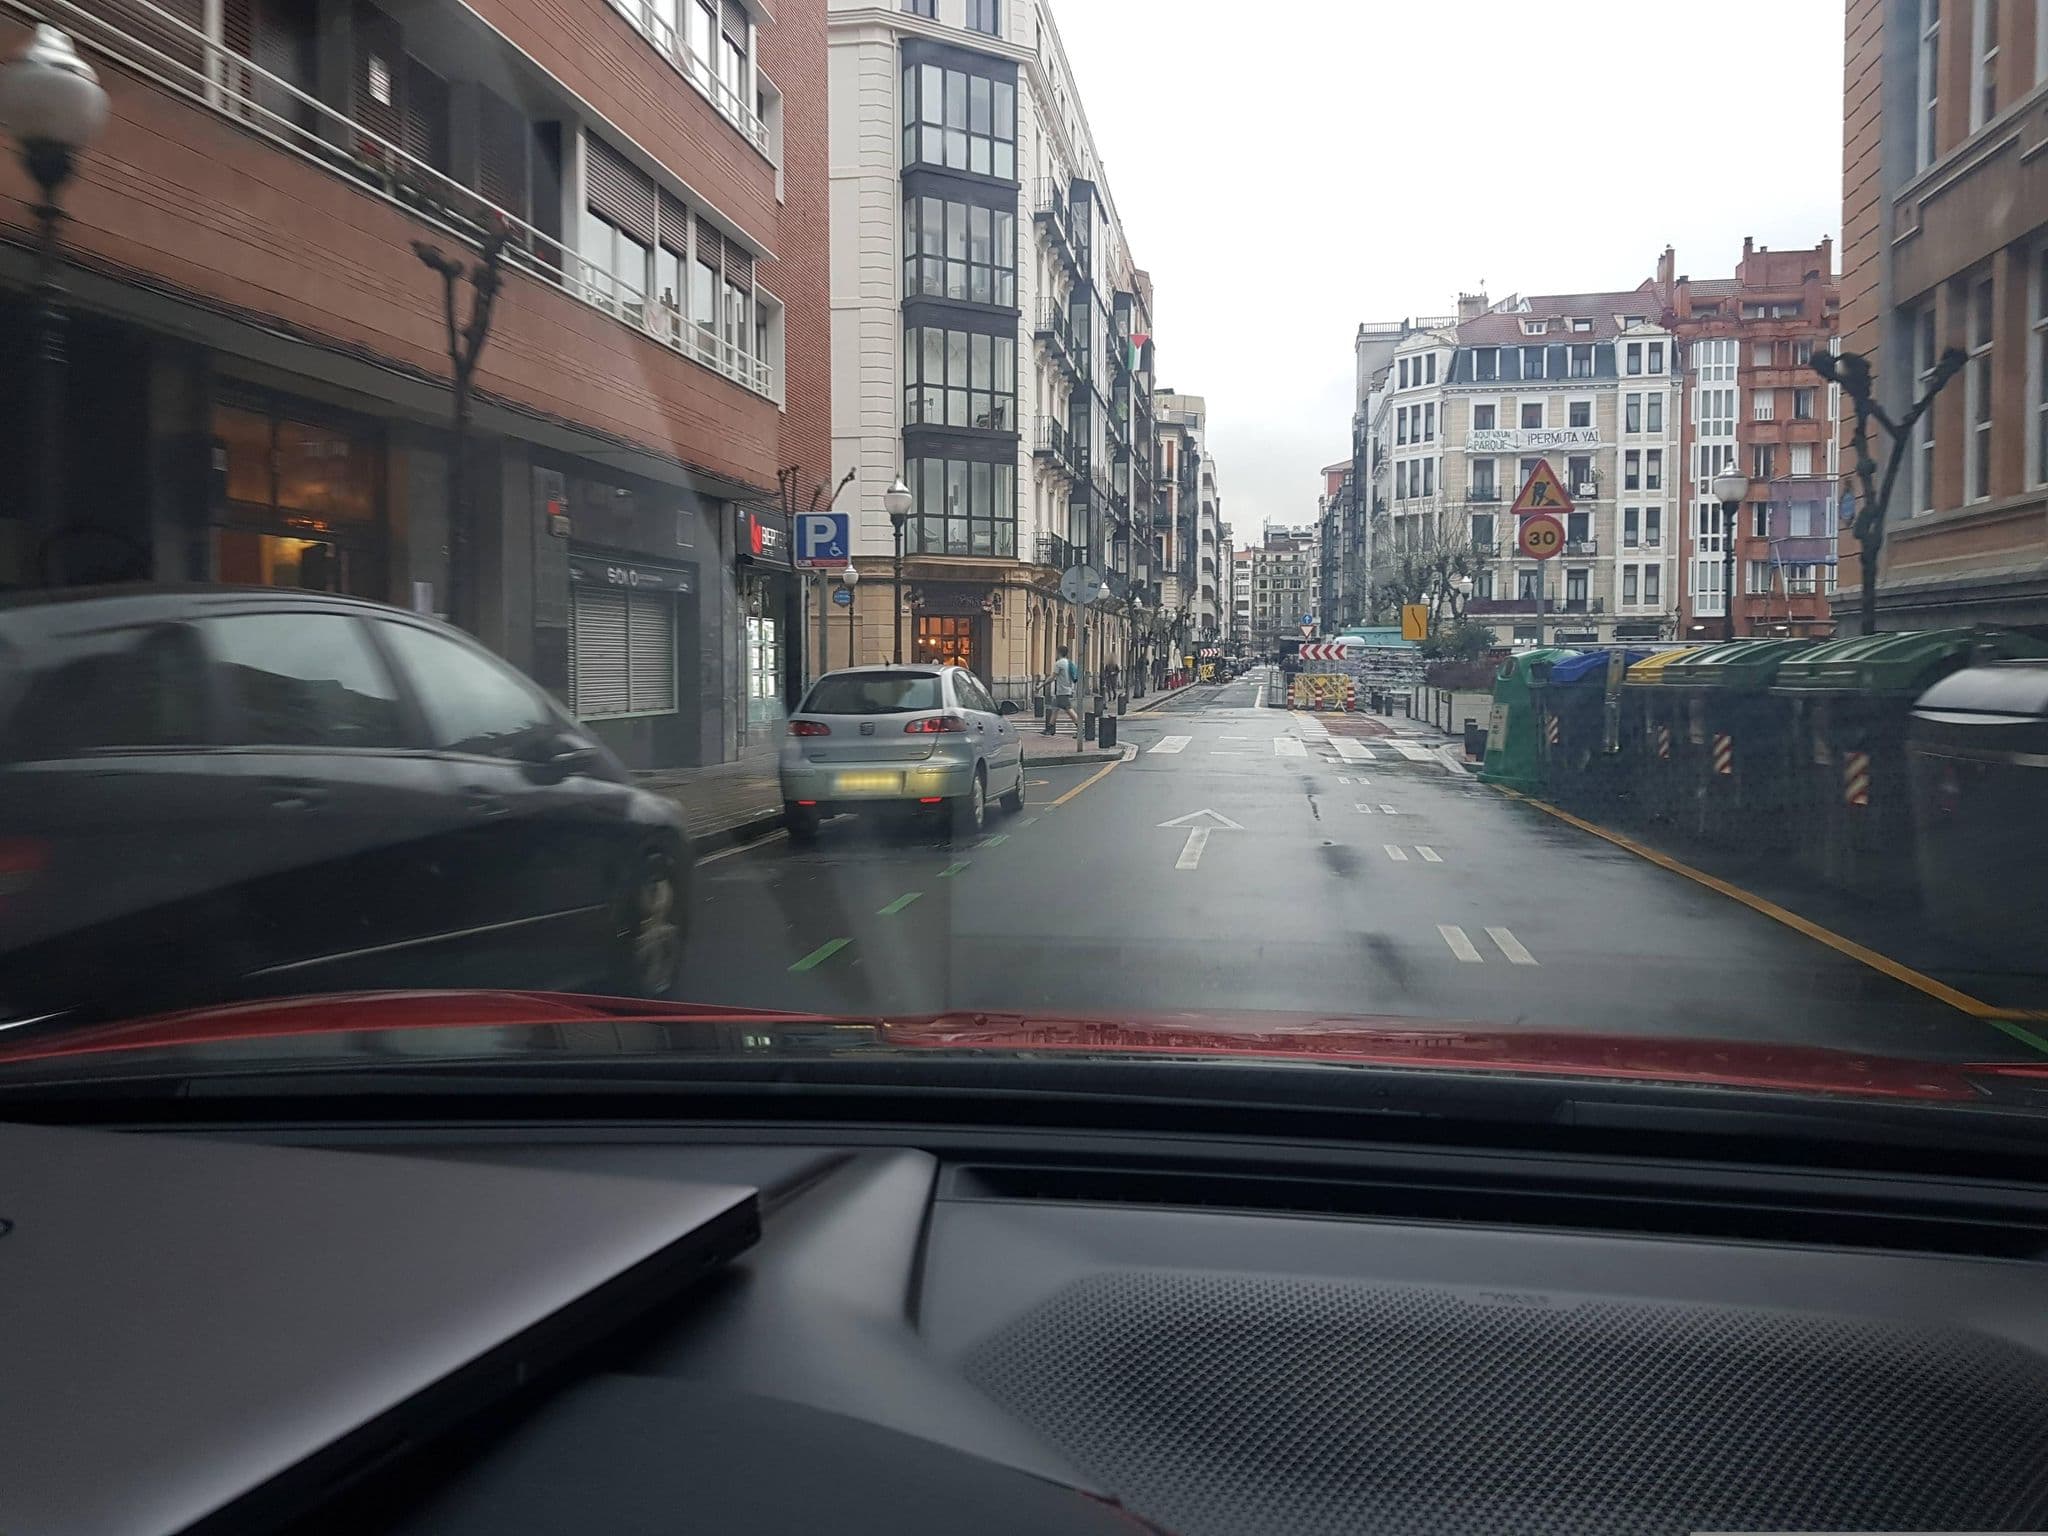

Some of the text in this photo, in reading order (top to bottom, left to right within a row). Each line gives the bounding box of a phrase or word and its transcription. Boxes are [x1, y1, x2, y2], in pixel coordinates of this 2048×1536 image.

[1582, 430, 1599, 442] YA!
[1474, 440, 1507, 451] PARQUE
[806, 516, 837, 558] P
[1529, 531, 1556, 546] 30
